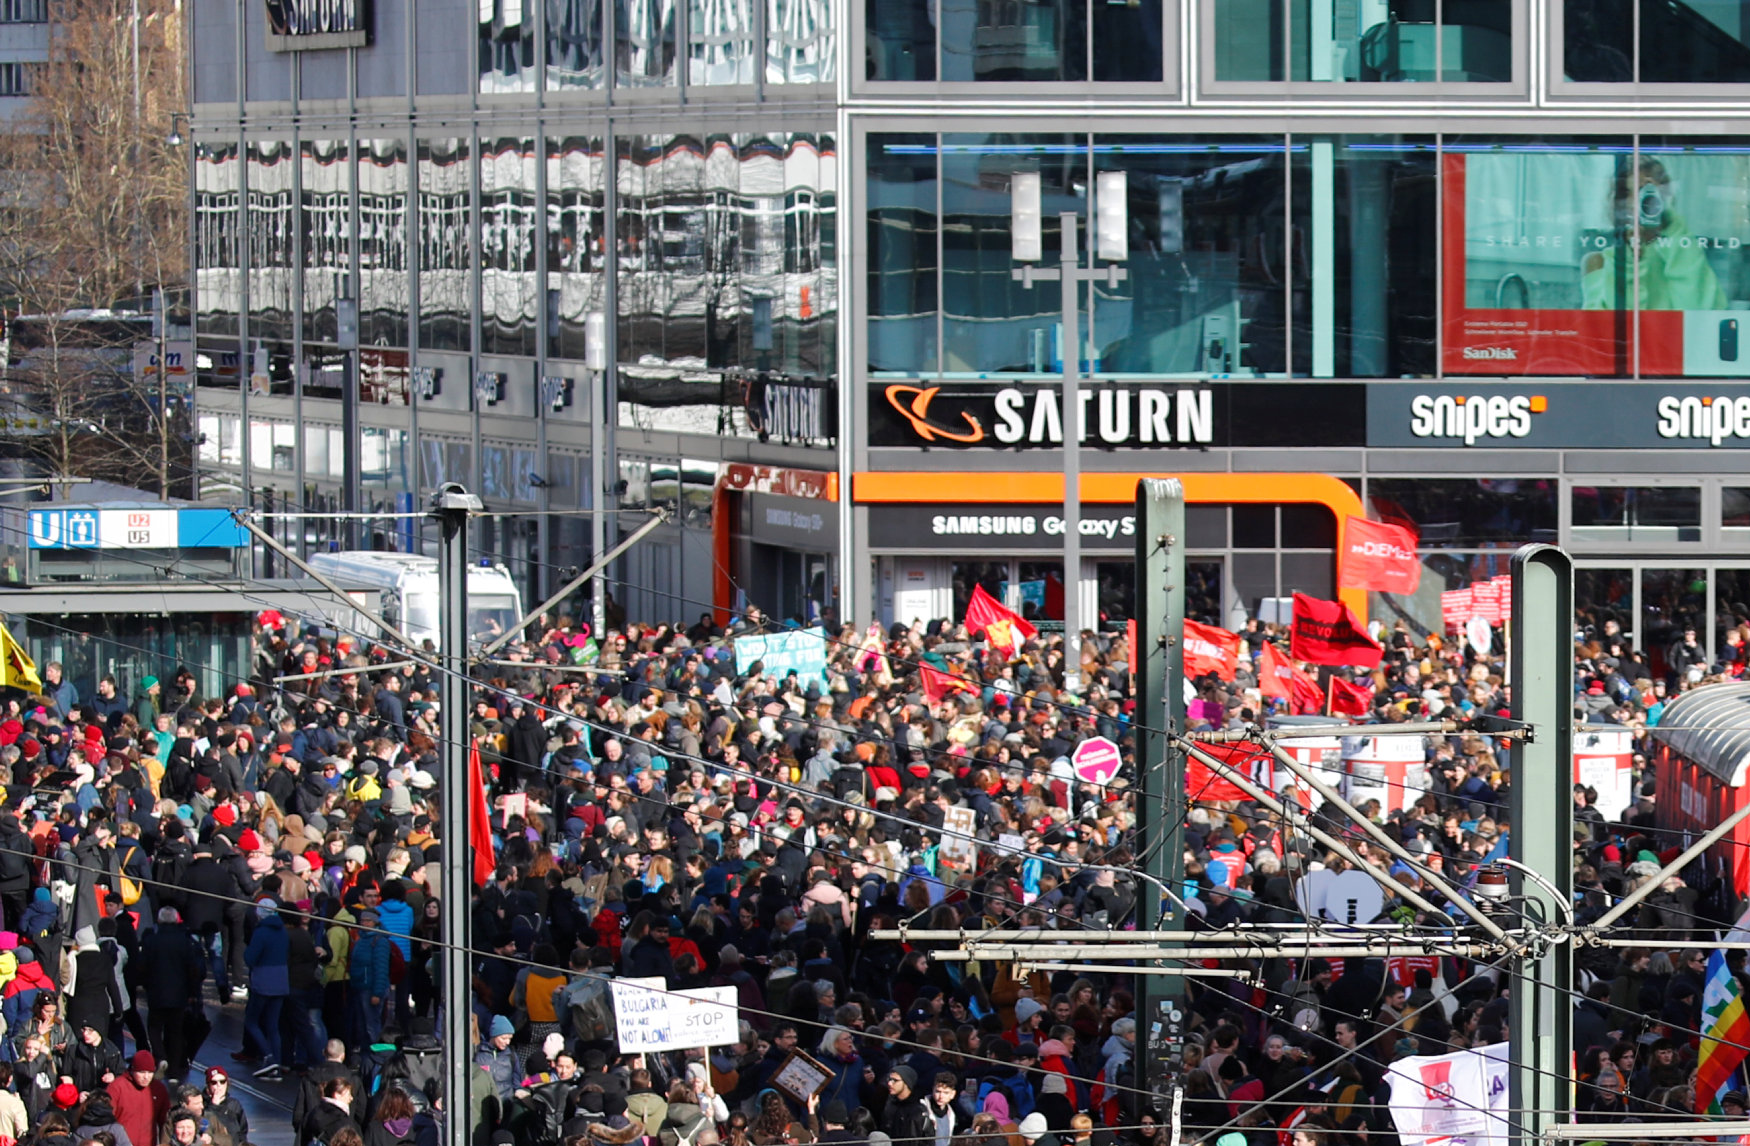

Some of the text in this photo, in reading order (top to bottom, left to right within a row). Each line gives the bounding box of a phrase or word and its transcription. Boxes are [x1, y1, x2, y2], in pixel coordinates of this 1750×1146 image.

[1486, 236, 1562, 248] SHARE
[1658, 236, 1741, 249] WORLD
[1463, 346, 1517, 360] SanDisk
[1411, 395, 1531, 445] snipes
[130, 514, 149, 526] U2
[932, 516, 1036, 534] SAMSUNG
[32, 513, 60, 546] U
[130, 531, 149, 543] U5
[621, 996, 668, 1013] BULGARIA
[686, 1012, 724, 1027] STOP
[621, 1030, 638, 1044] NOT
